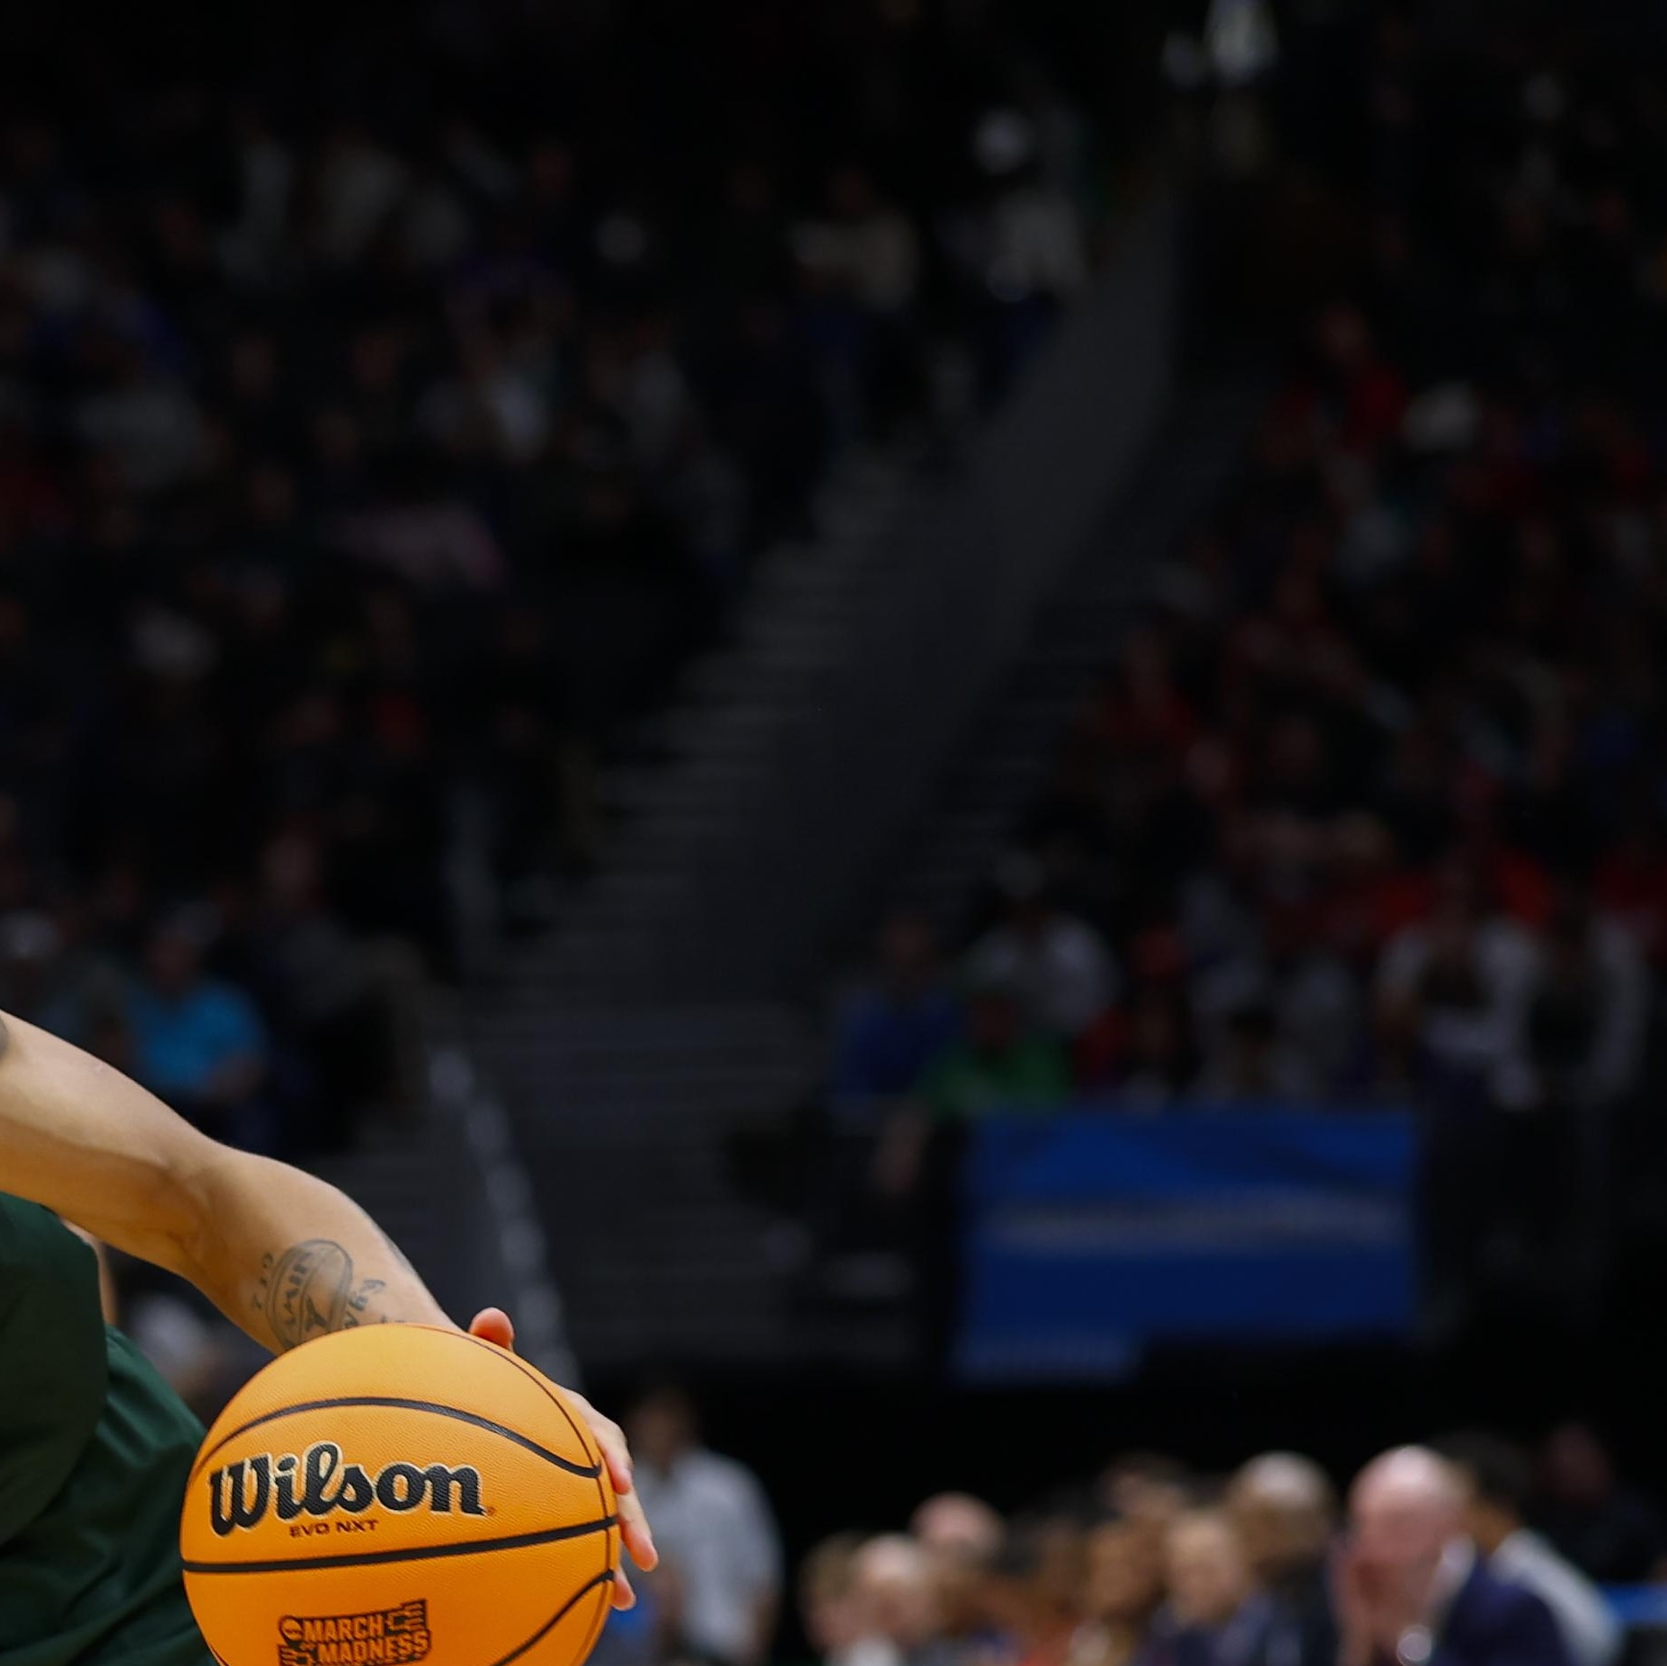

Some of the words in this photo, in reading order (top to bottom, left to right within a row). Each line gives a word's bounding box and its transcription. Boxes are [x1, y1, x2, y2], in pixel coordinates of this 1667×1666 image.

[209, 1440, 489, 1538] Wilson
[336, 1519, 380, 1534] NXT
[303, 1614, 384, 1642] MARCH
[317, 1630, 429, 1665] MADNESS
